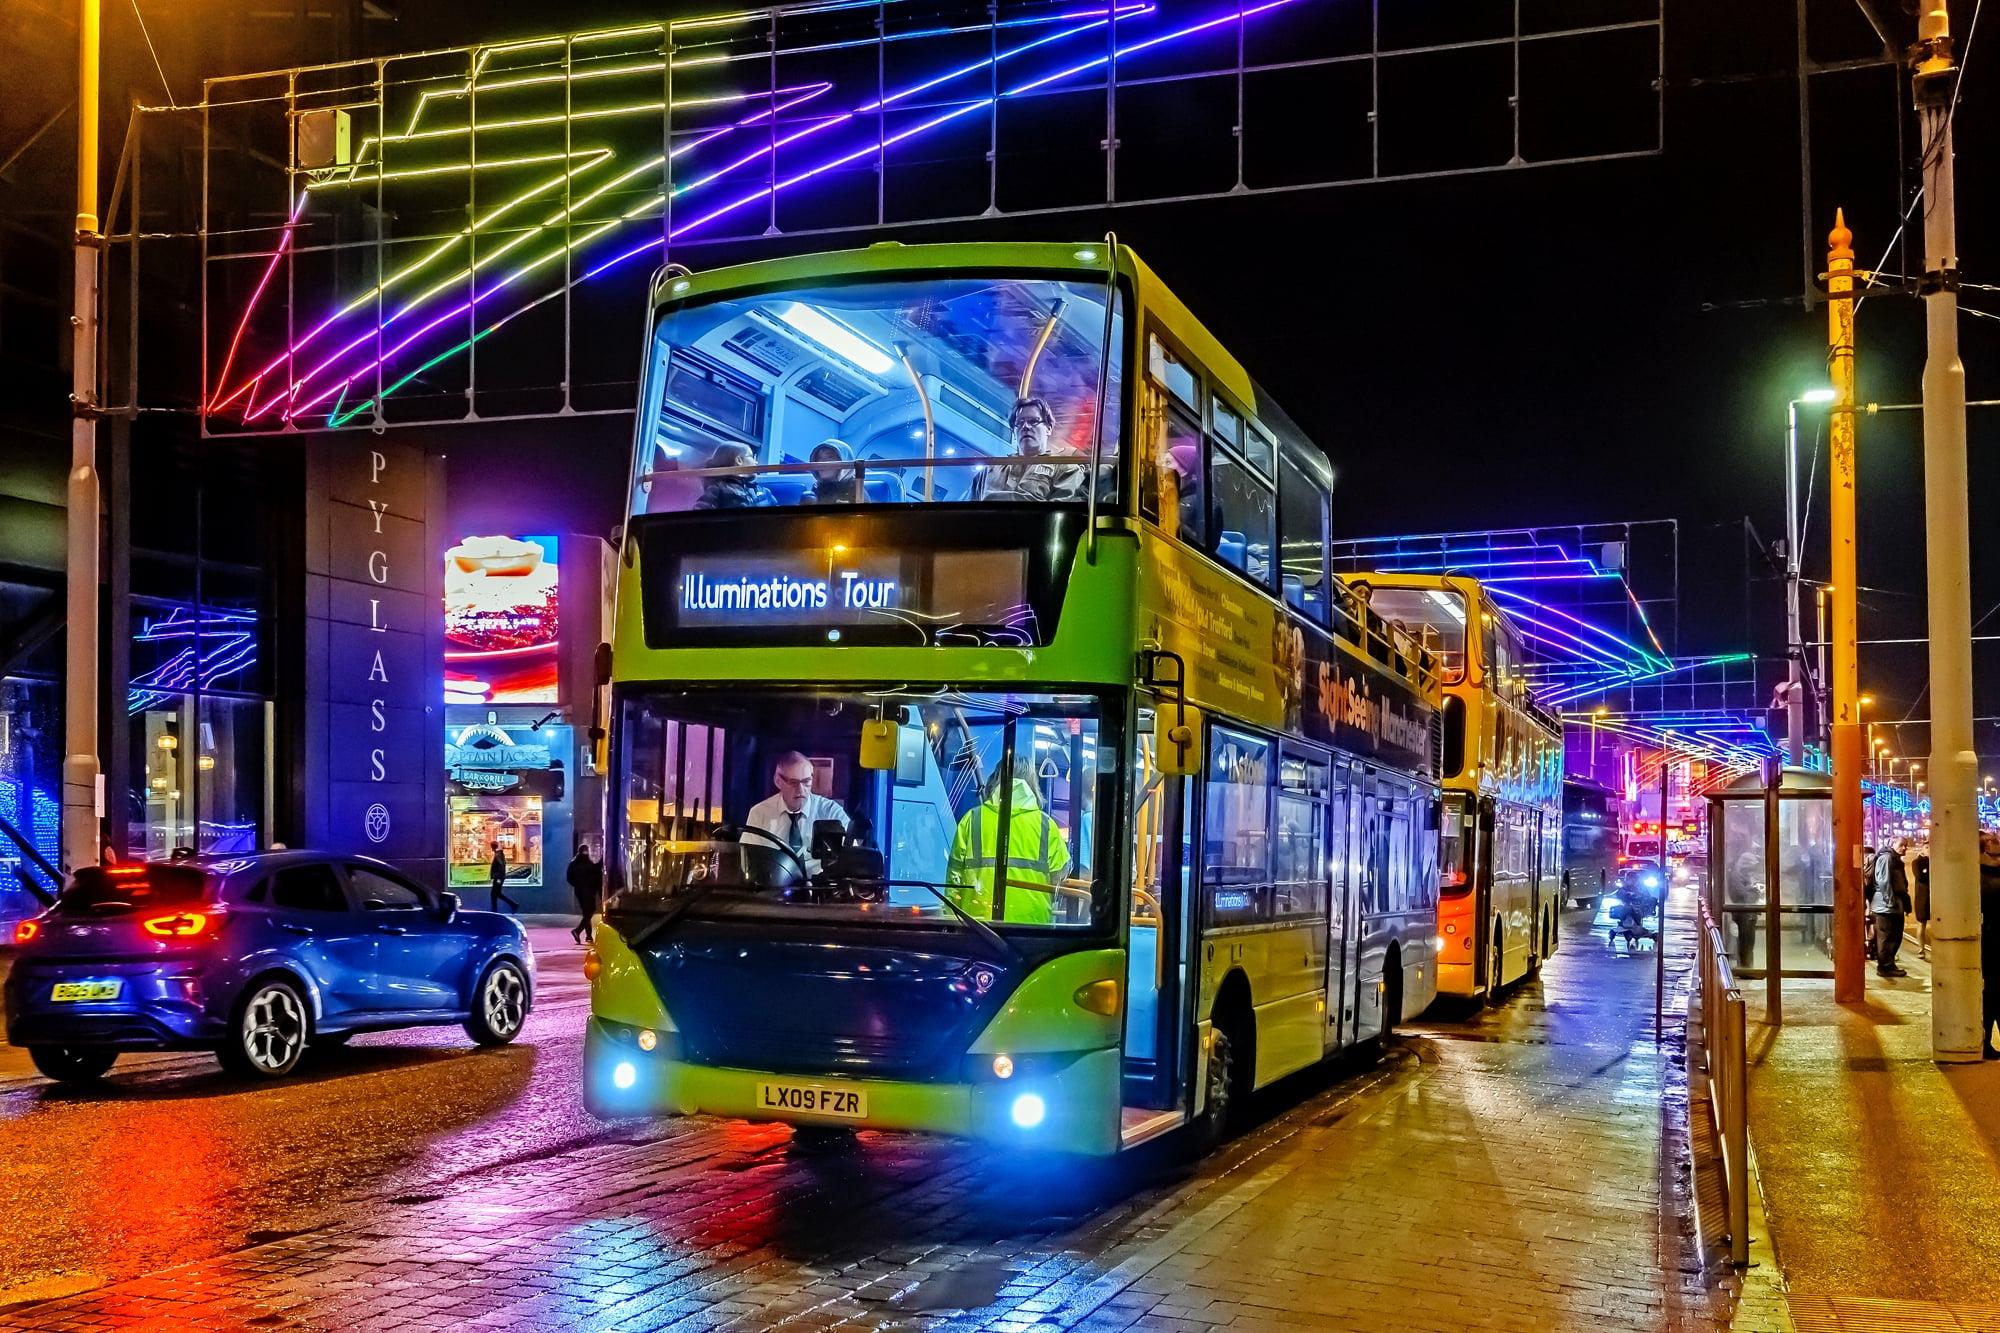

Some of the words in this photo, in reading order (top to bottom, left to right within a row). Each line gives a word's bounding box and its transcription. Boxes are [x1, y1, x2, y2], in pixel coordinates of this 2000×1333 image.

[684, 573, 828, 609] Illuminations
[841, 571, 895, 608] Tour
[1381, 694, 1427, 756] Manchester
[765, 1085, 815, 1109] LX09
[820, 1090, 859, 1113] FZR
